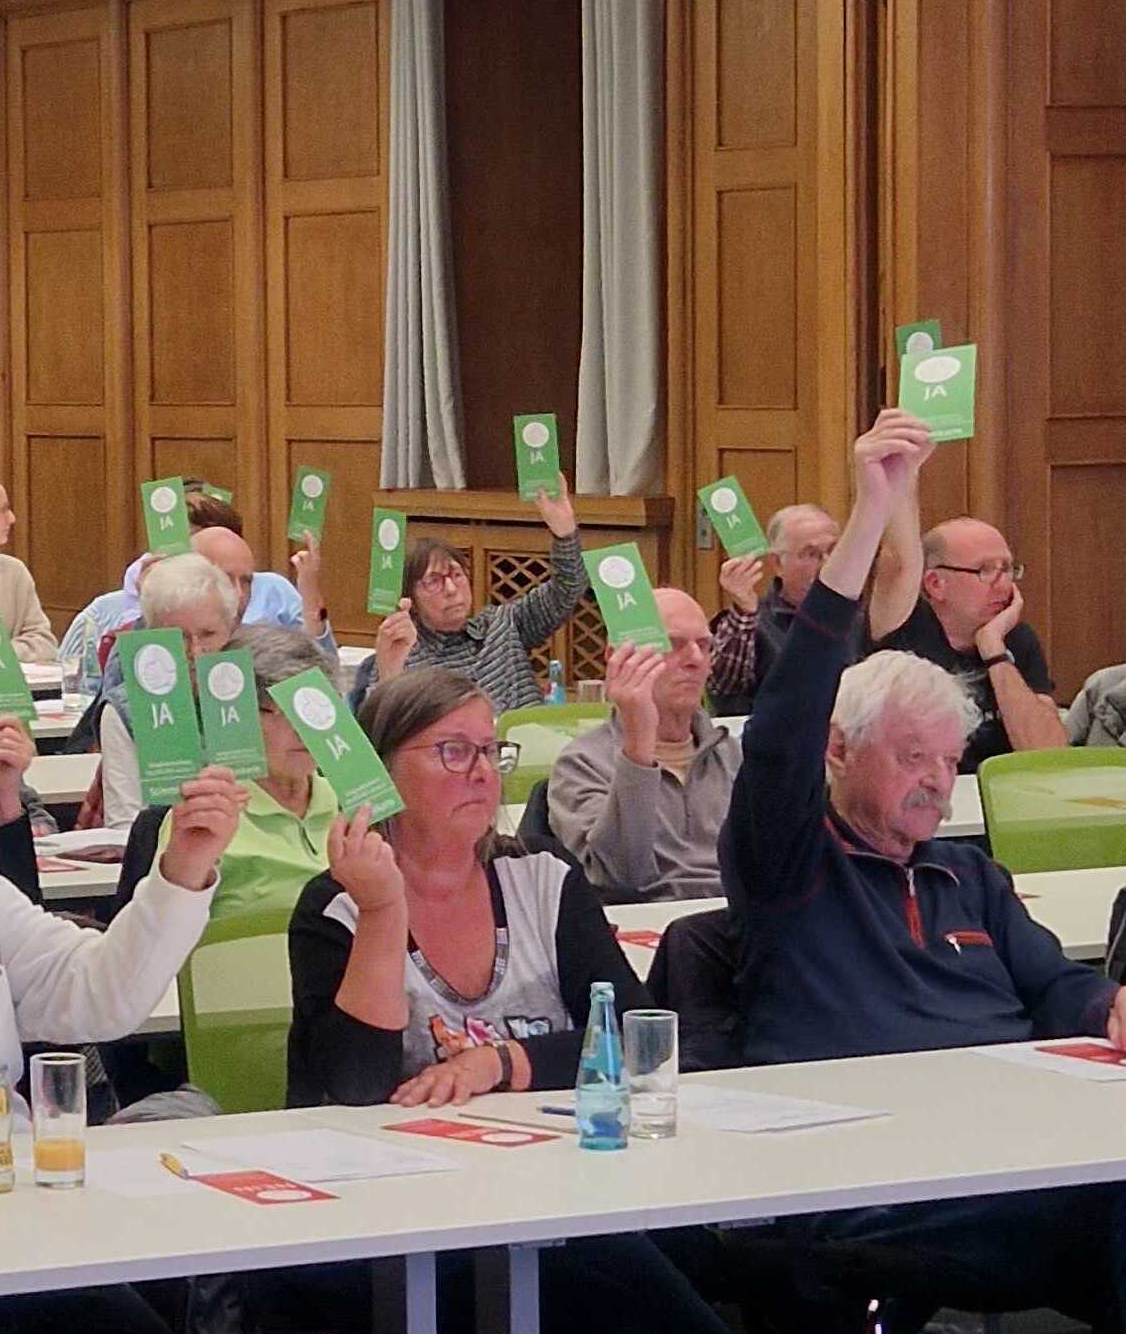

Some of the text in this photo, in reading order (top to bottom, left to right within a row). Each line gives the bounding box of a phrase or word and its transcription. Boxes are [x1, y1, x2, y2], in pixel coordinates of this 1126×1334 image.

[923, 384, 947, 402] JA
[529, 450, 545, 465] JA
[159, 515, 174, 531] JA
[616, 591, 638, 611] JA
[151, 701, 174, 729] JA
[220, 705, 241, 727] JA
[325, 733, 352, 761] JA
